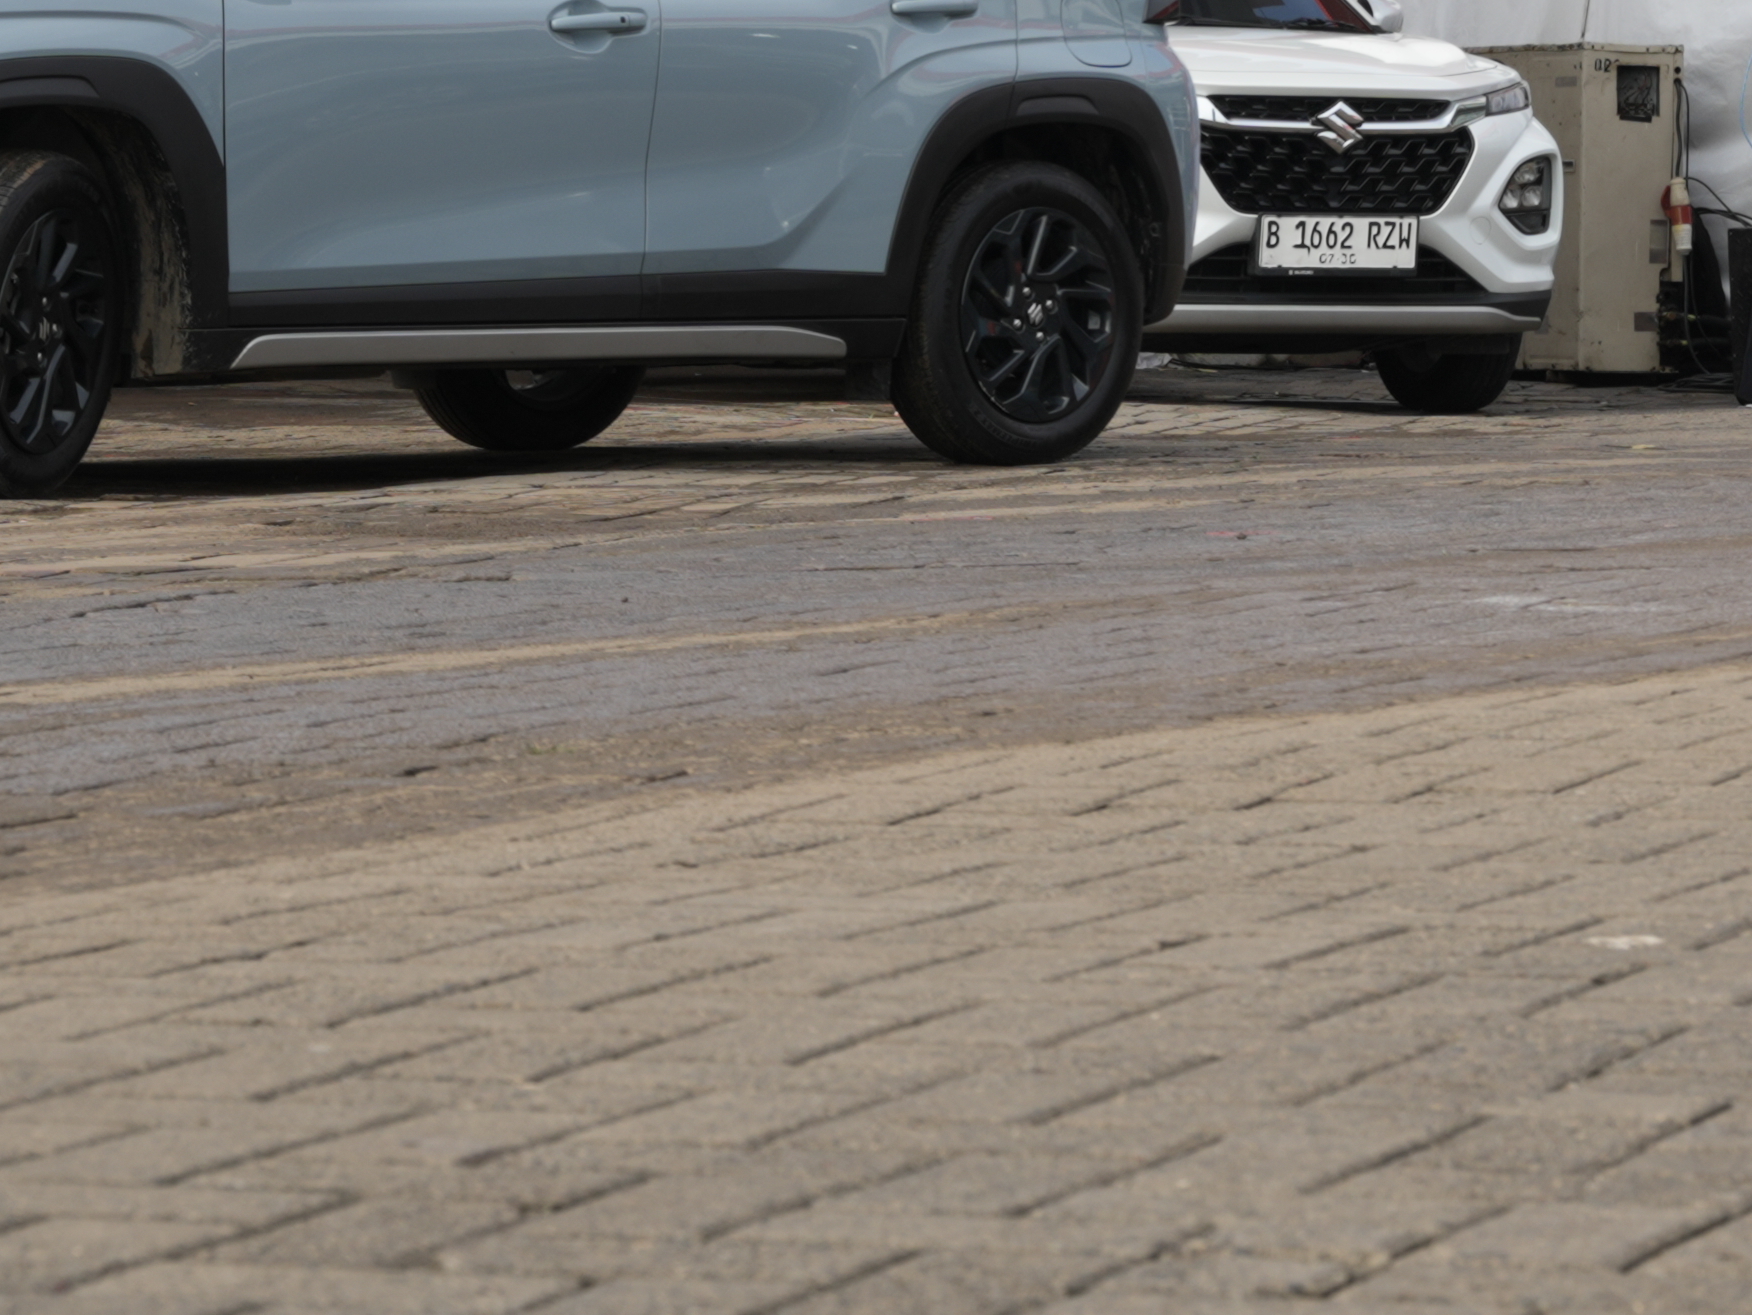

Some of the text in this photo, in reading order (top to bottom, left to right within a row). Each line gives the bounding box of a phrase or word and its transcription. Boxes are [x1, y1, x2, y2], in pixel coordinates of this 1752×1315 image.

[1266, 220, 1413, 251] B 1662 RZW
